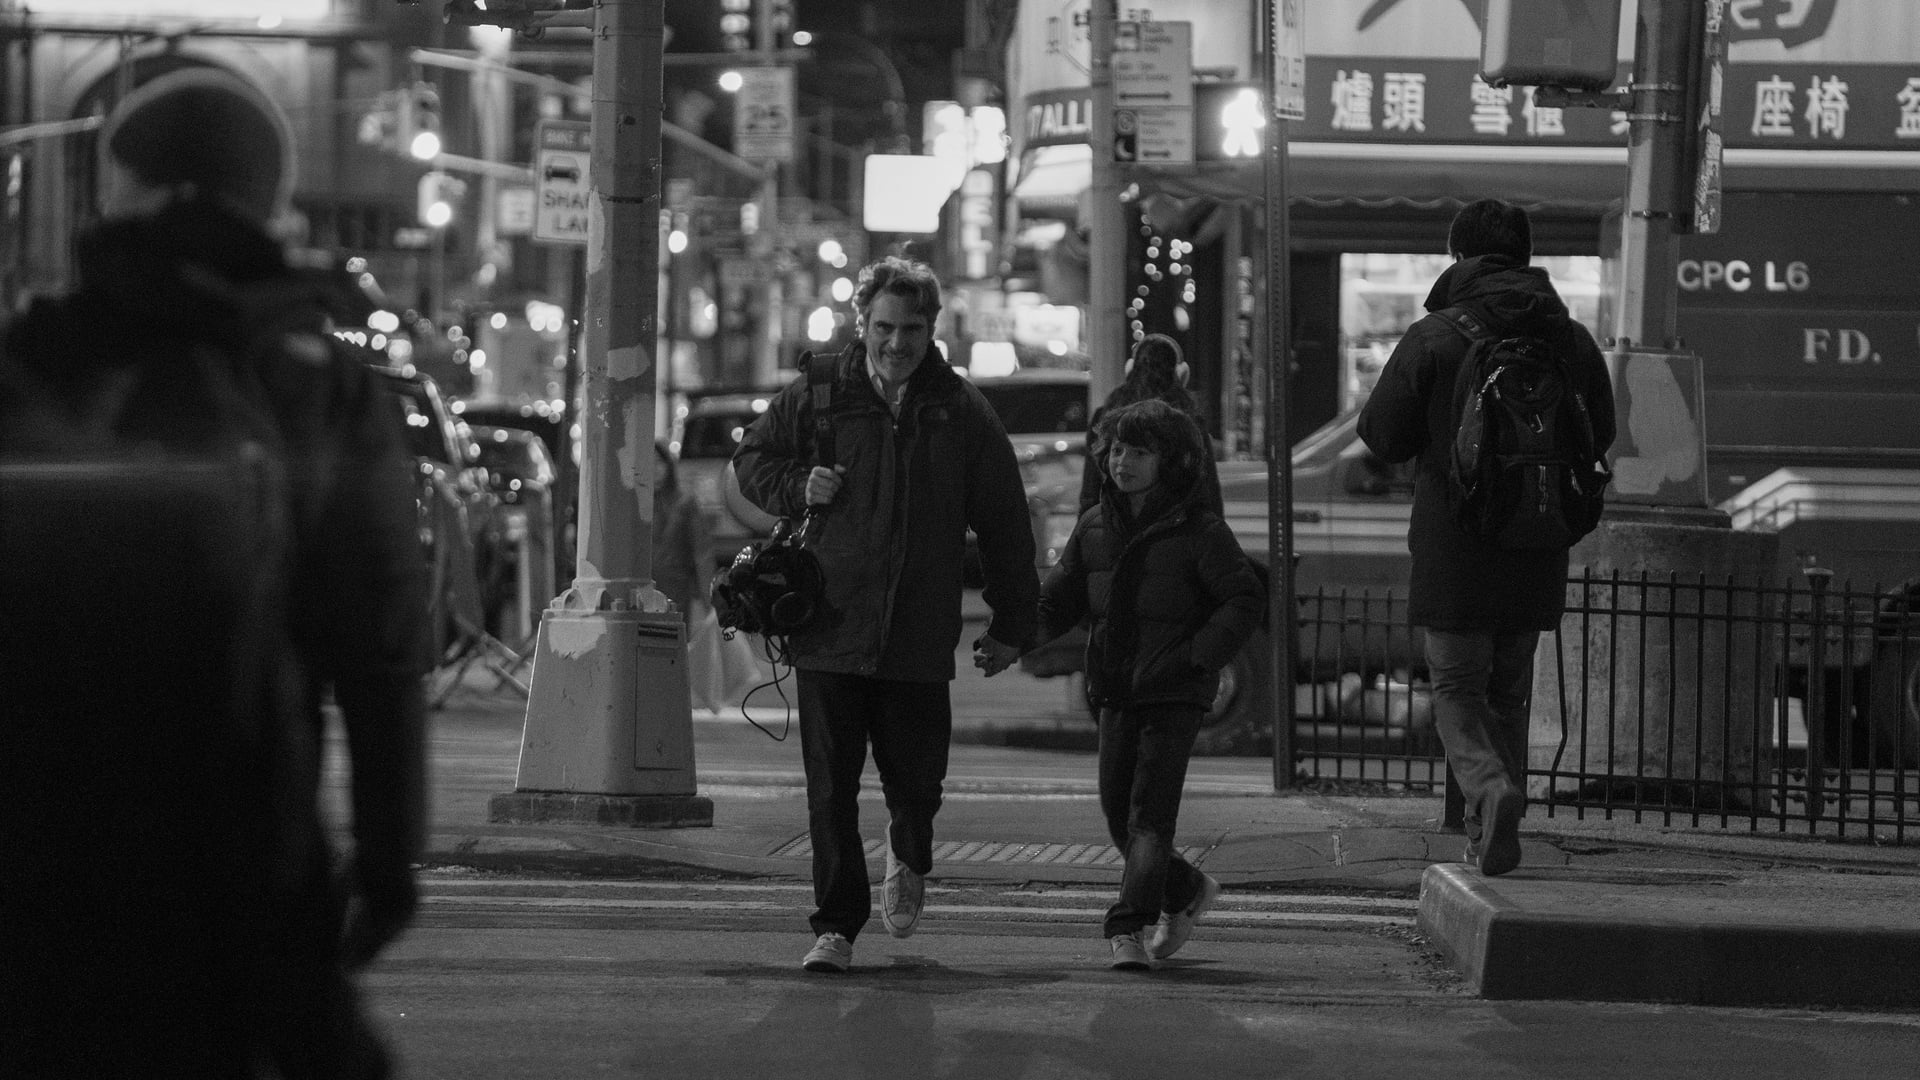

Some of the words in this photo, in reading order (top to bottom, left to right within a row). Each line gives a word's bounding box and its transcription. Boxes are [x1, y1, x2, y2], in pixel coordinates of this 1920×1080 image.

[1752, 74, 1850, 139] 座椅
[1677, 260, 1753, 292] CPC
[1765, 260, 1811, 292] L6
[1803, 327, 1882, 364] FD.
